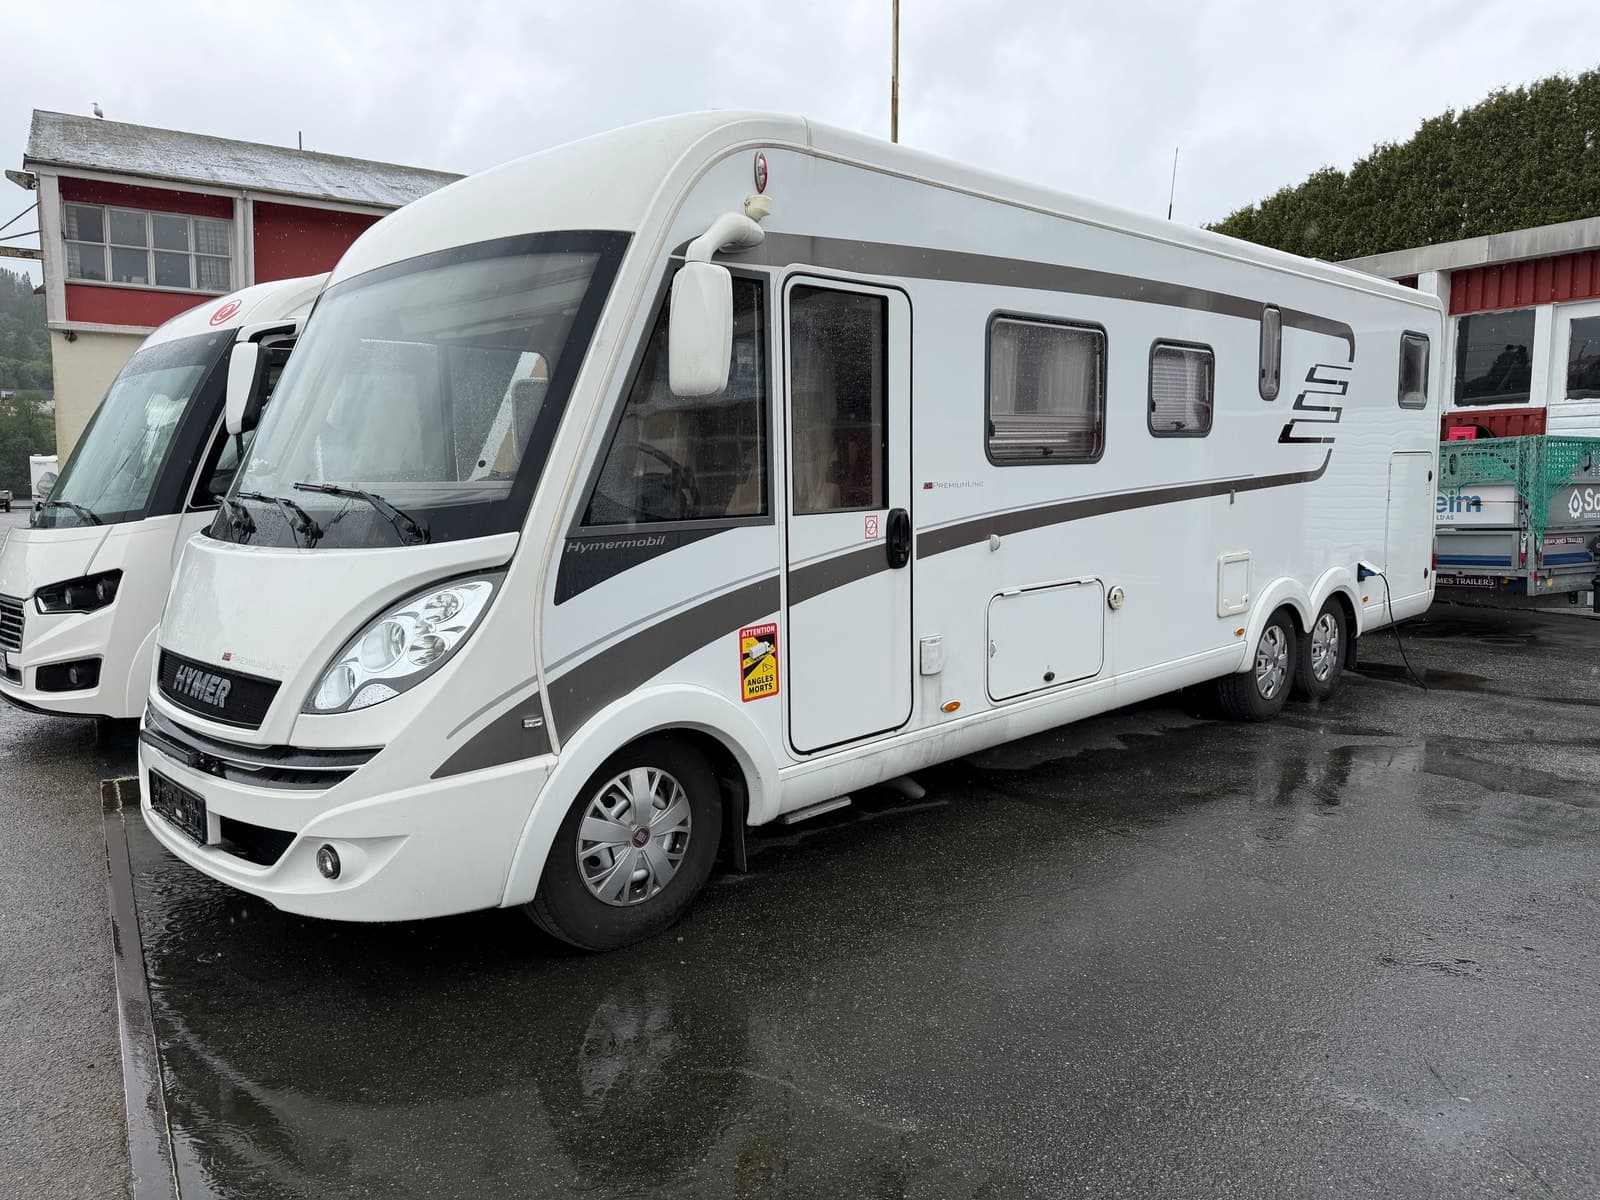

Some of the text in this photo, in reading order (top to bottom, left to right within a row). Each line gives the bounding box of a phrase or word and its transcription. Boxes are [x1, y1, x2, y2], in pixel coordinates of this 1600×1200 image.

[566, 535, 666, 554] Hymermobil
[1455, 578, 1495, 586] TRAILERS
[741, 625, 776, 638] ATTENTION
[173, 664, 232, 708] HYMER
[747, 675, 774, 687] ANGLES
[748, 683, 773, 694] MORTS
